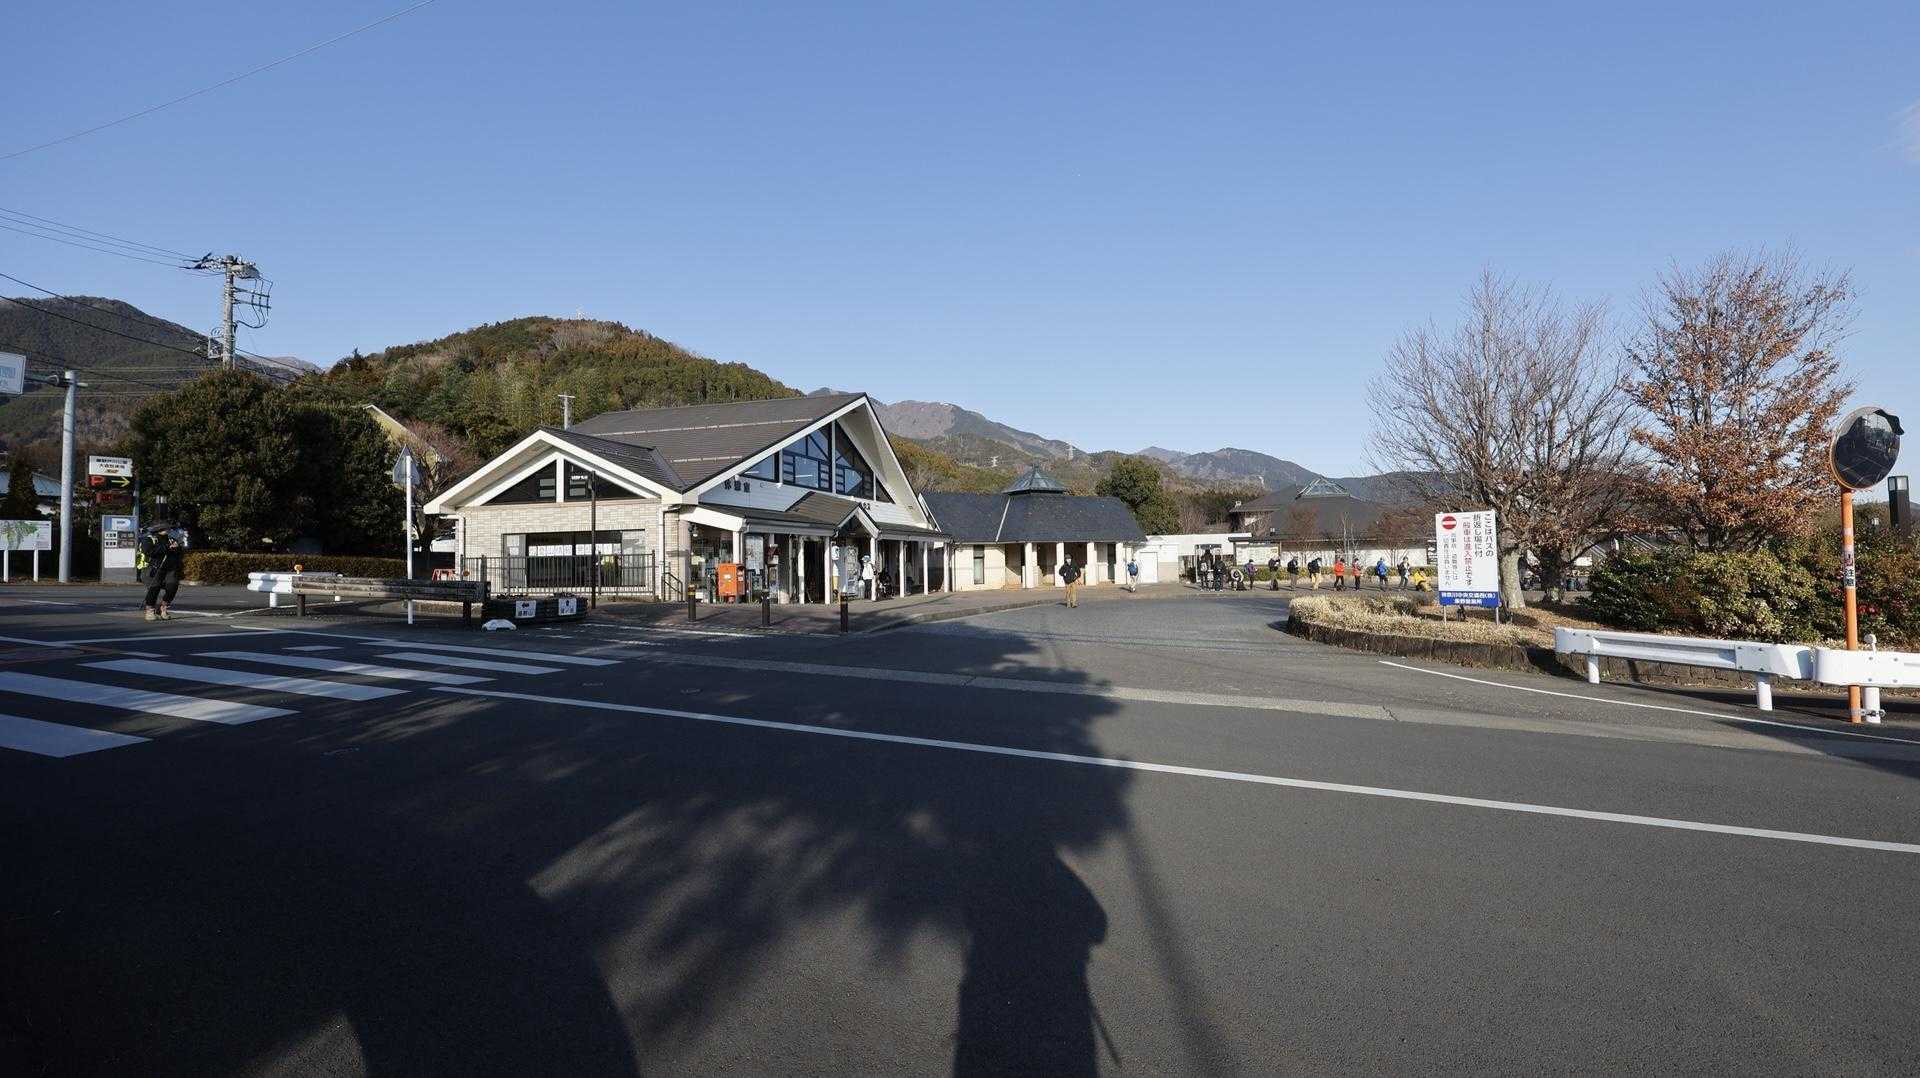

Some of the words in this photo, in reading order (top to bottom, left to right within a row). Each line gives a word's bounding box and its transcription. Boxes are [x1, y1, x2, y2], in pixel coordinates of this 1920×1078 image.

[1473, 514, 1483, 558] 折返し場に付
[1485, 514, 1494, 557] ここはバスの
[1844, 568, 1854, 586] 注意
